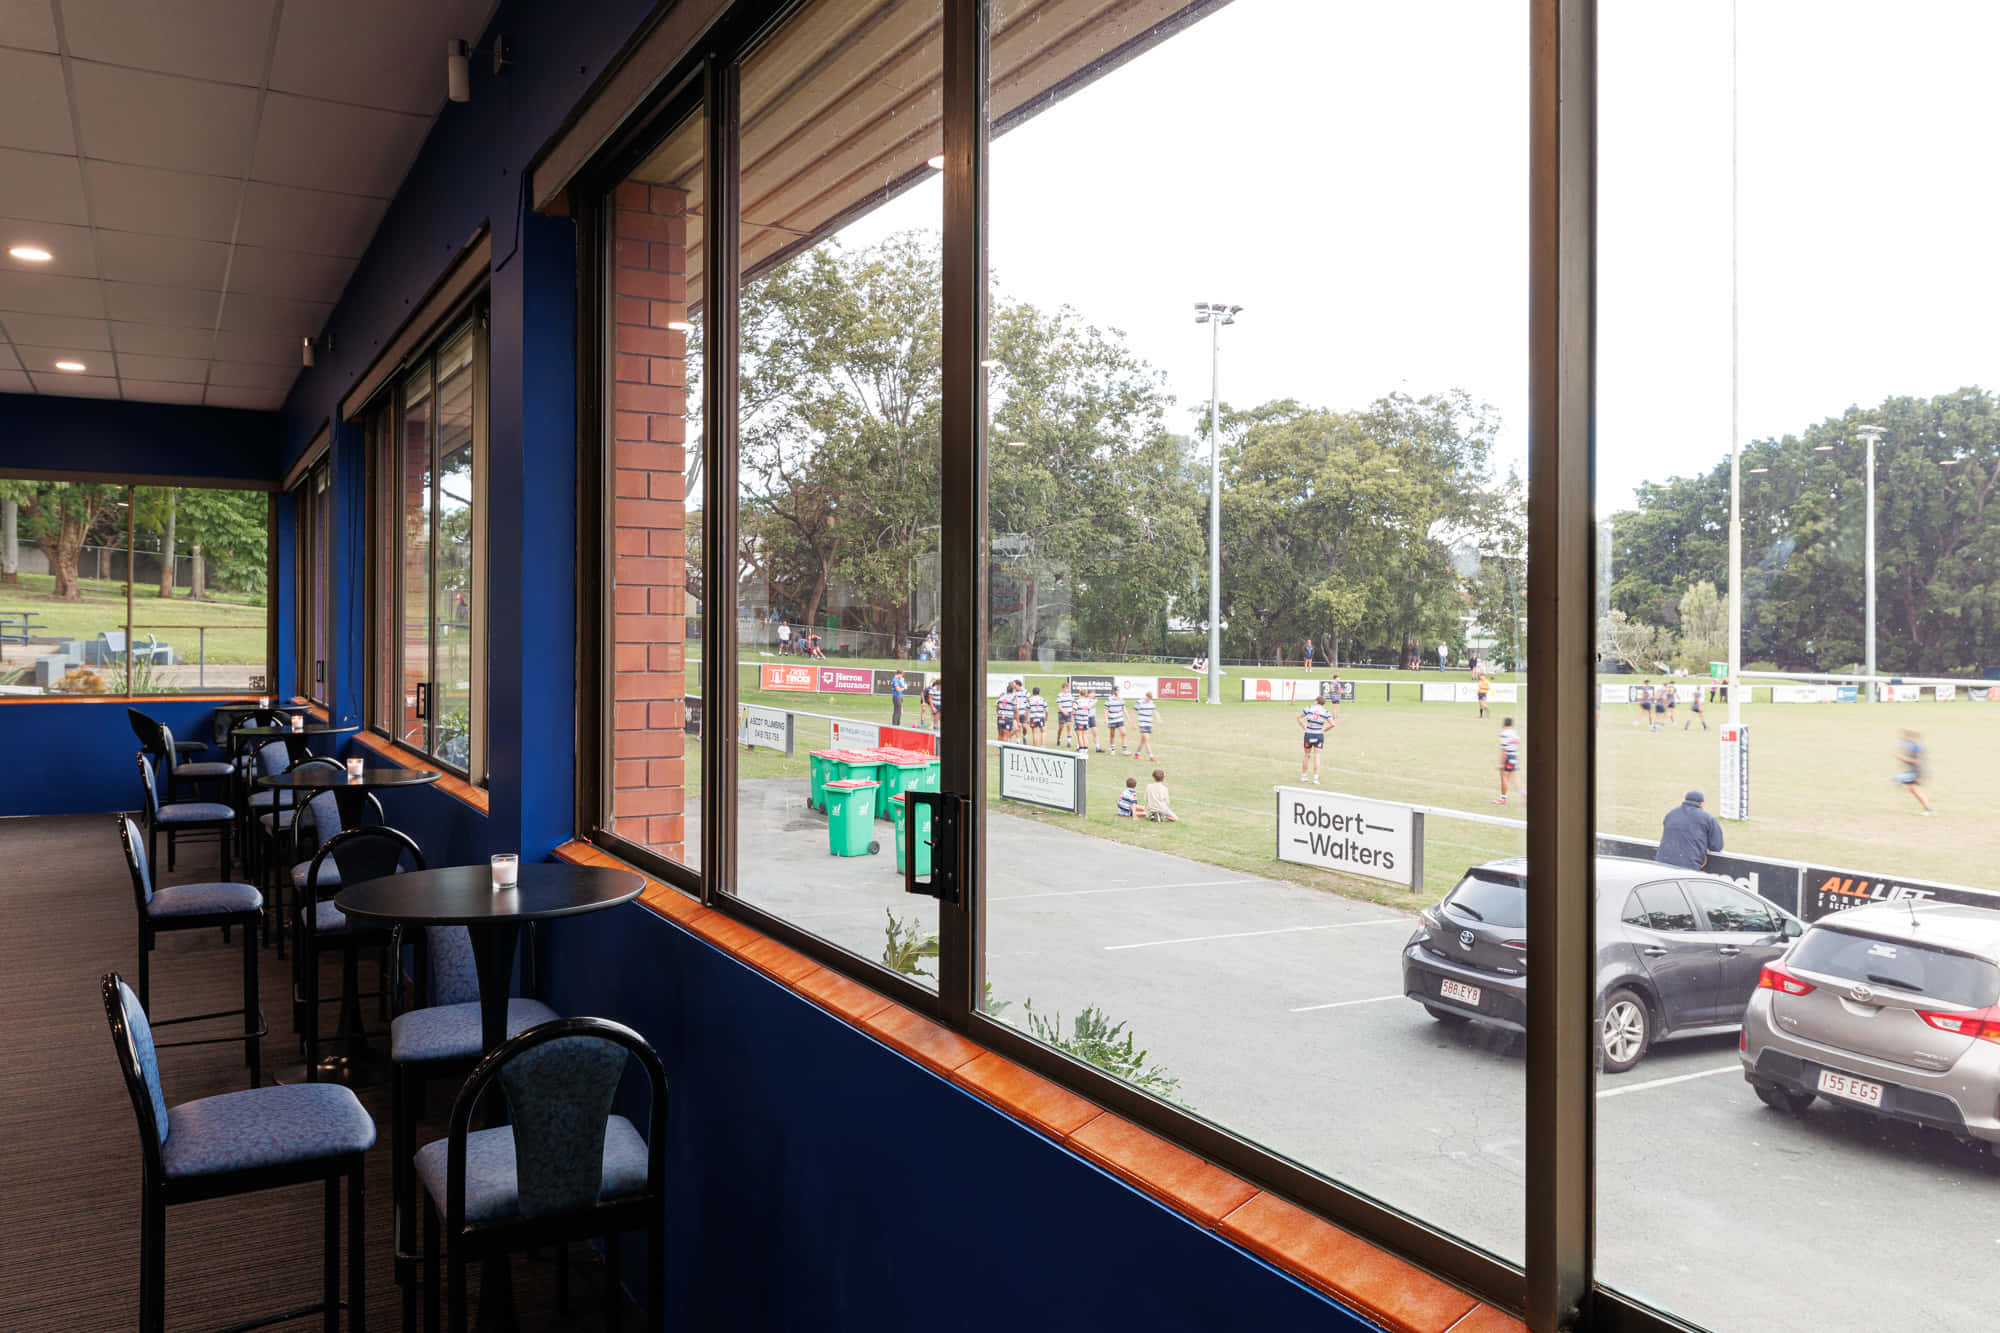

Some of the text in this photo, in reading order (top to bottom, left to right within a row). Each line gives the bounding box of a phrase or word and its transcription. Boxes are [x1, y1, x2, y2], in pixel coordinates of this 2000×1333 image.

[836, 680, 870, 689] Insurance
[1010, 753, 1067, 778] HANNAY
[1823, 1073, 1879, 1101] 155 EG5
